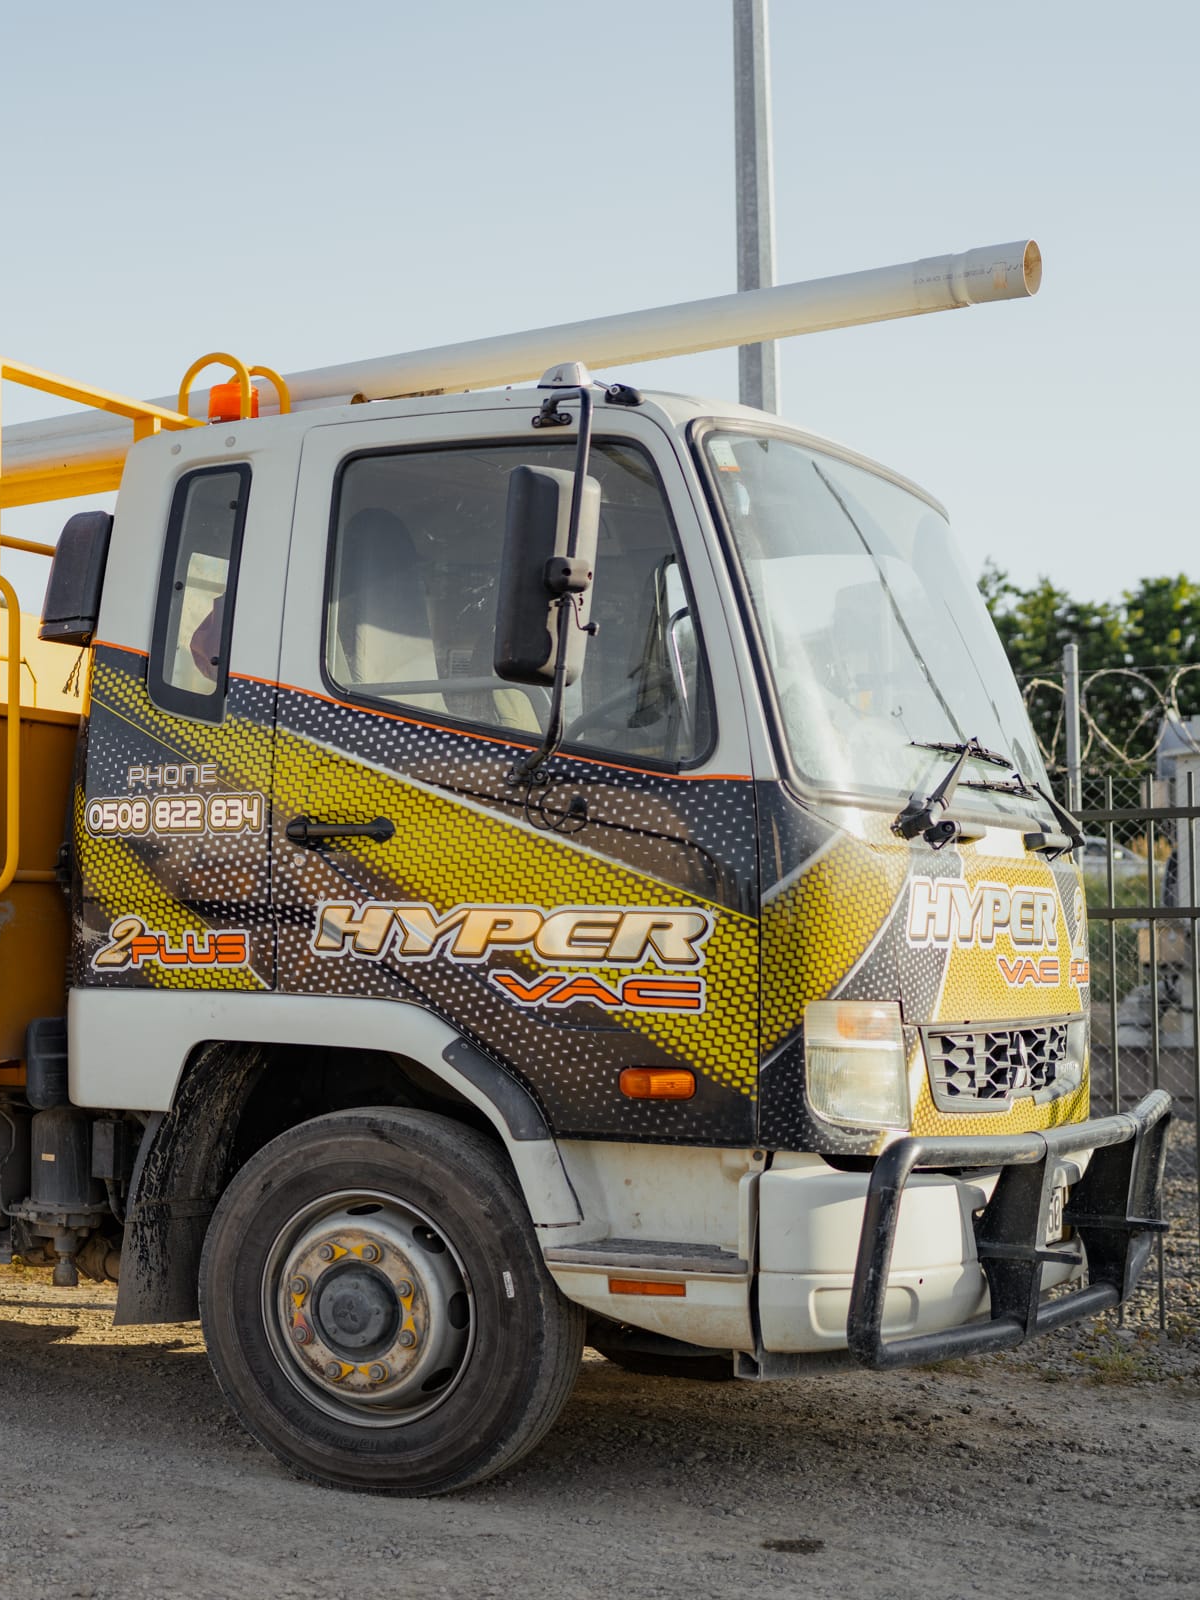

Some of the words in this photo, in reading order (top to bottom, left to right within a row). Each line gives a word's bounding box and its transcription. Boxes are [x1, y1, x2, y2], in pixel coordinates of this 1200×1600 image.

[128, 764, 218, 788] PHONE
[88, 797, 148, 831] 0508
[153, 796, 202, 831] 822
[209, 796, 260, 830] 834
[909, 881, 1058, 947] HYPER
[131, 933, 246, 965] PLUS
[314, 904, 708, 964] HYPER
[999, 957, 1059, 984] VAC
[493, 974, 701, 1009] VAC
